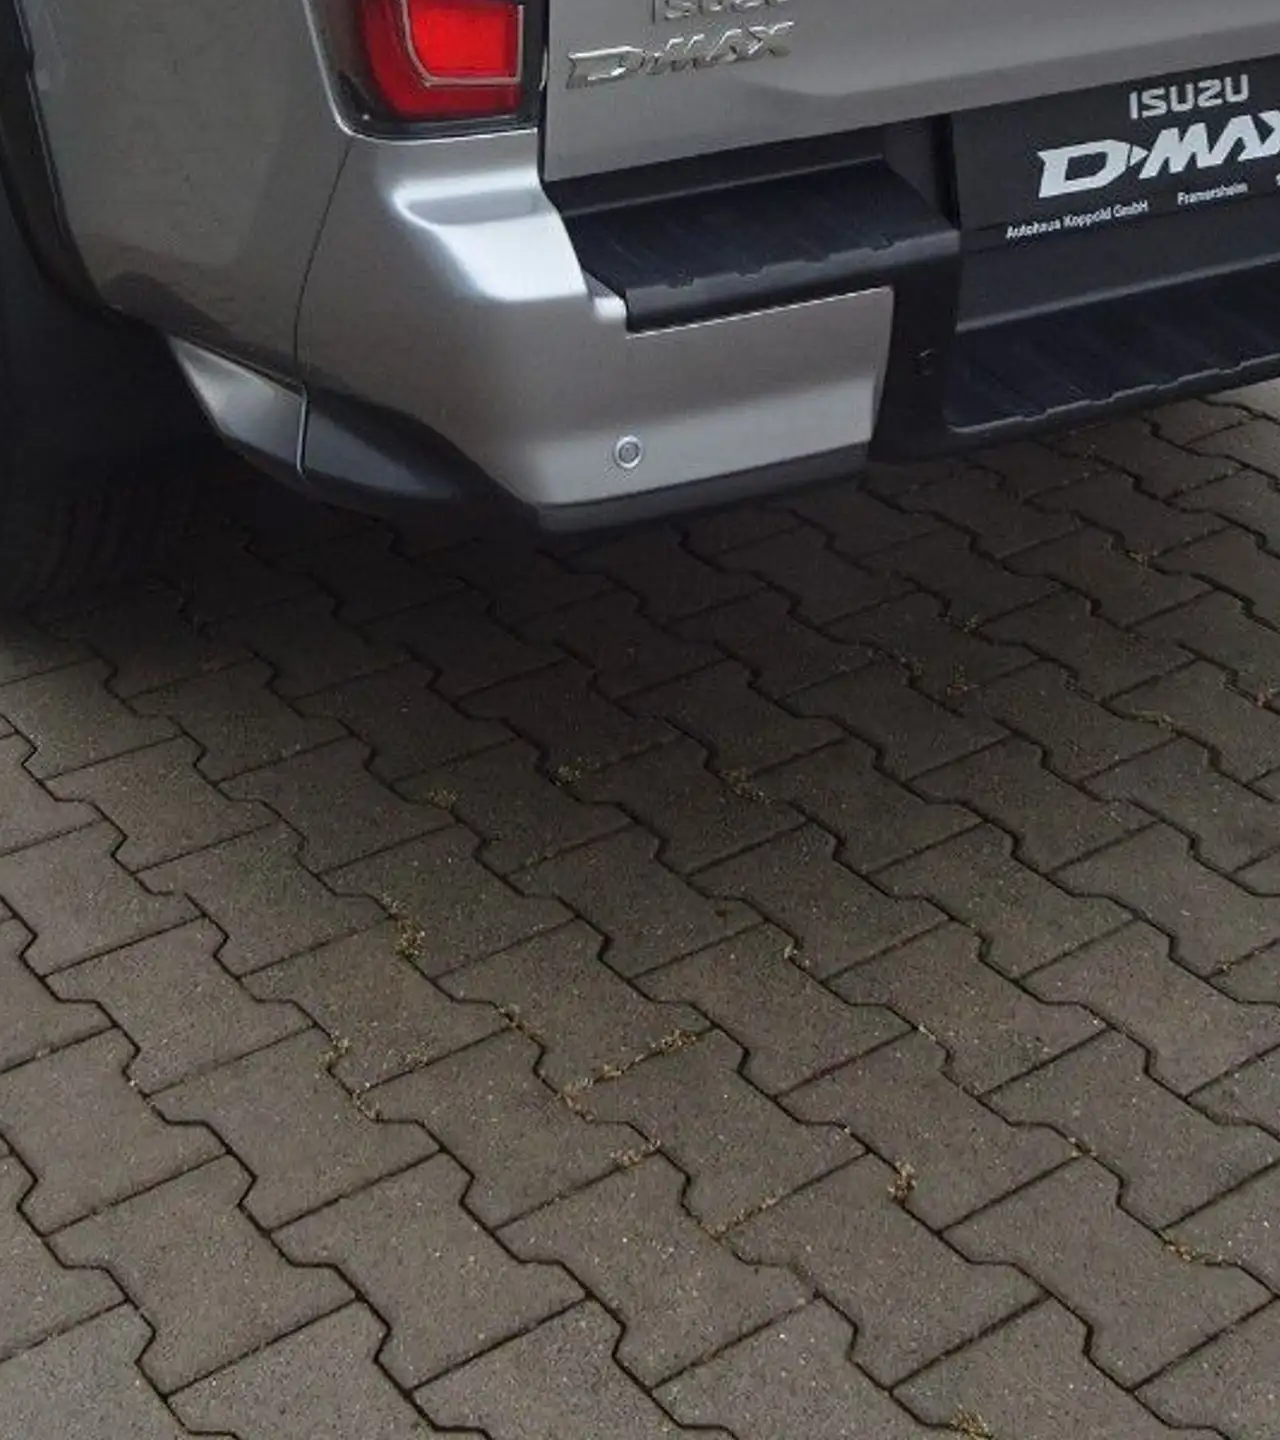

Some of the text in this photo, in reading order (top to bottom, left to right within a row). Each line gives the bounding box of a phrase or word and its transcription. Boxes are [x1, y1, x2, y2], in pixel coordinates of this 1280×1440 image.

[1128, 73, 1250, 121] ISUZU
[1005, 218, 1062, 240] Autohaus
[1112, 198, 1150, 218] GmbH
